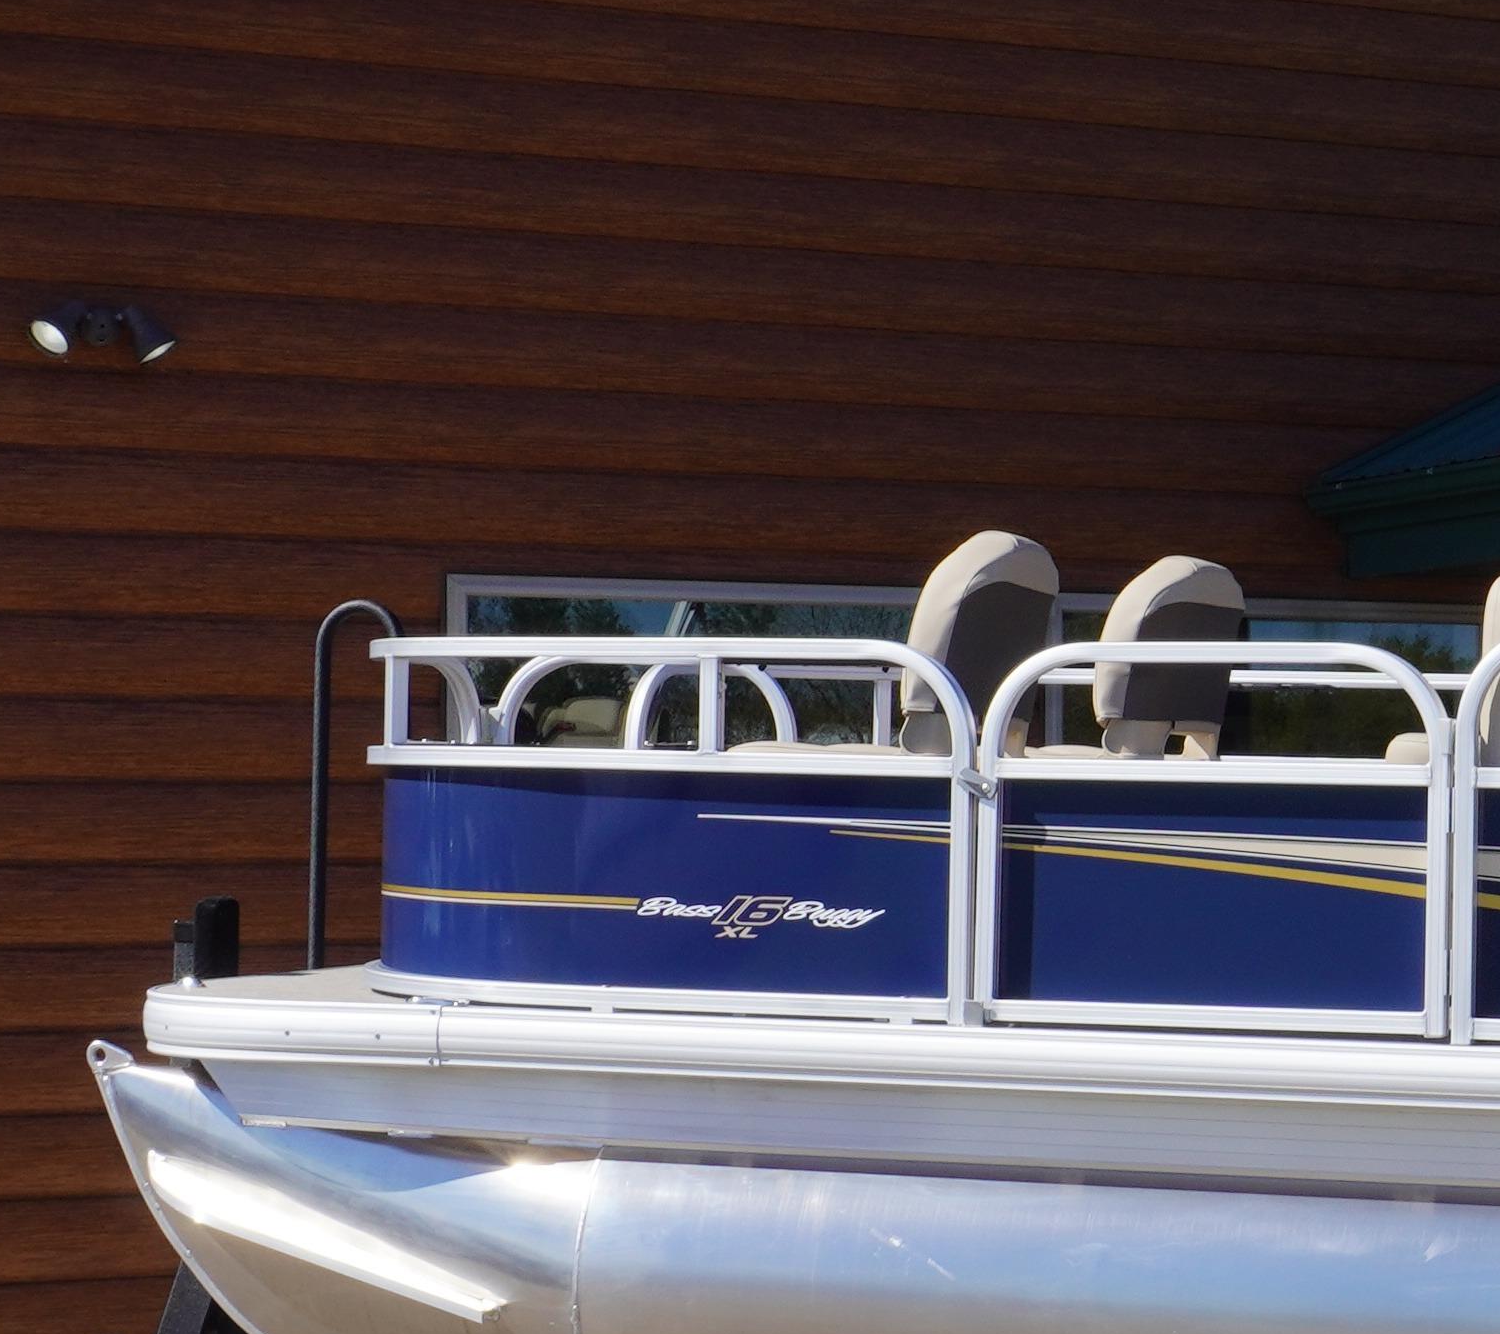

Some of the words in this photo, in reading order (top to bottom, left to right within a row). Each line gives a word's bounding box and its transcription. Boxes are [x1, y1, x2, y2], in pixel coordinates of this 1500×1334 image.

[637, 897, 722, 917] Bass
[711, 895, 793, 926] 16
[783, 900, 885, 929] Buggy
[715, 926, 758, 939] XL
